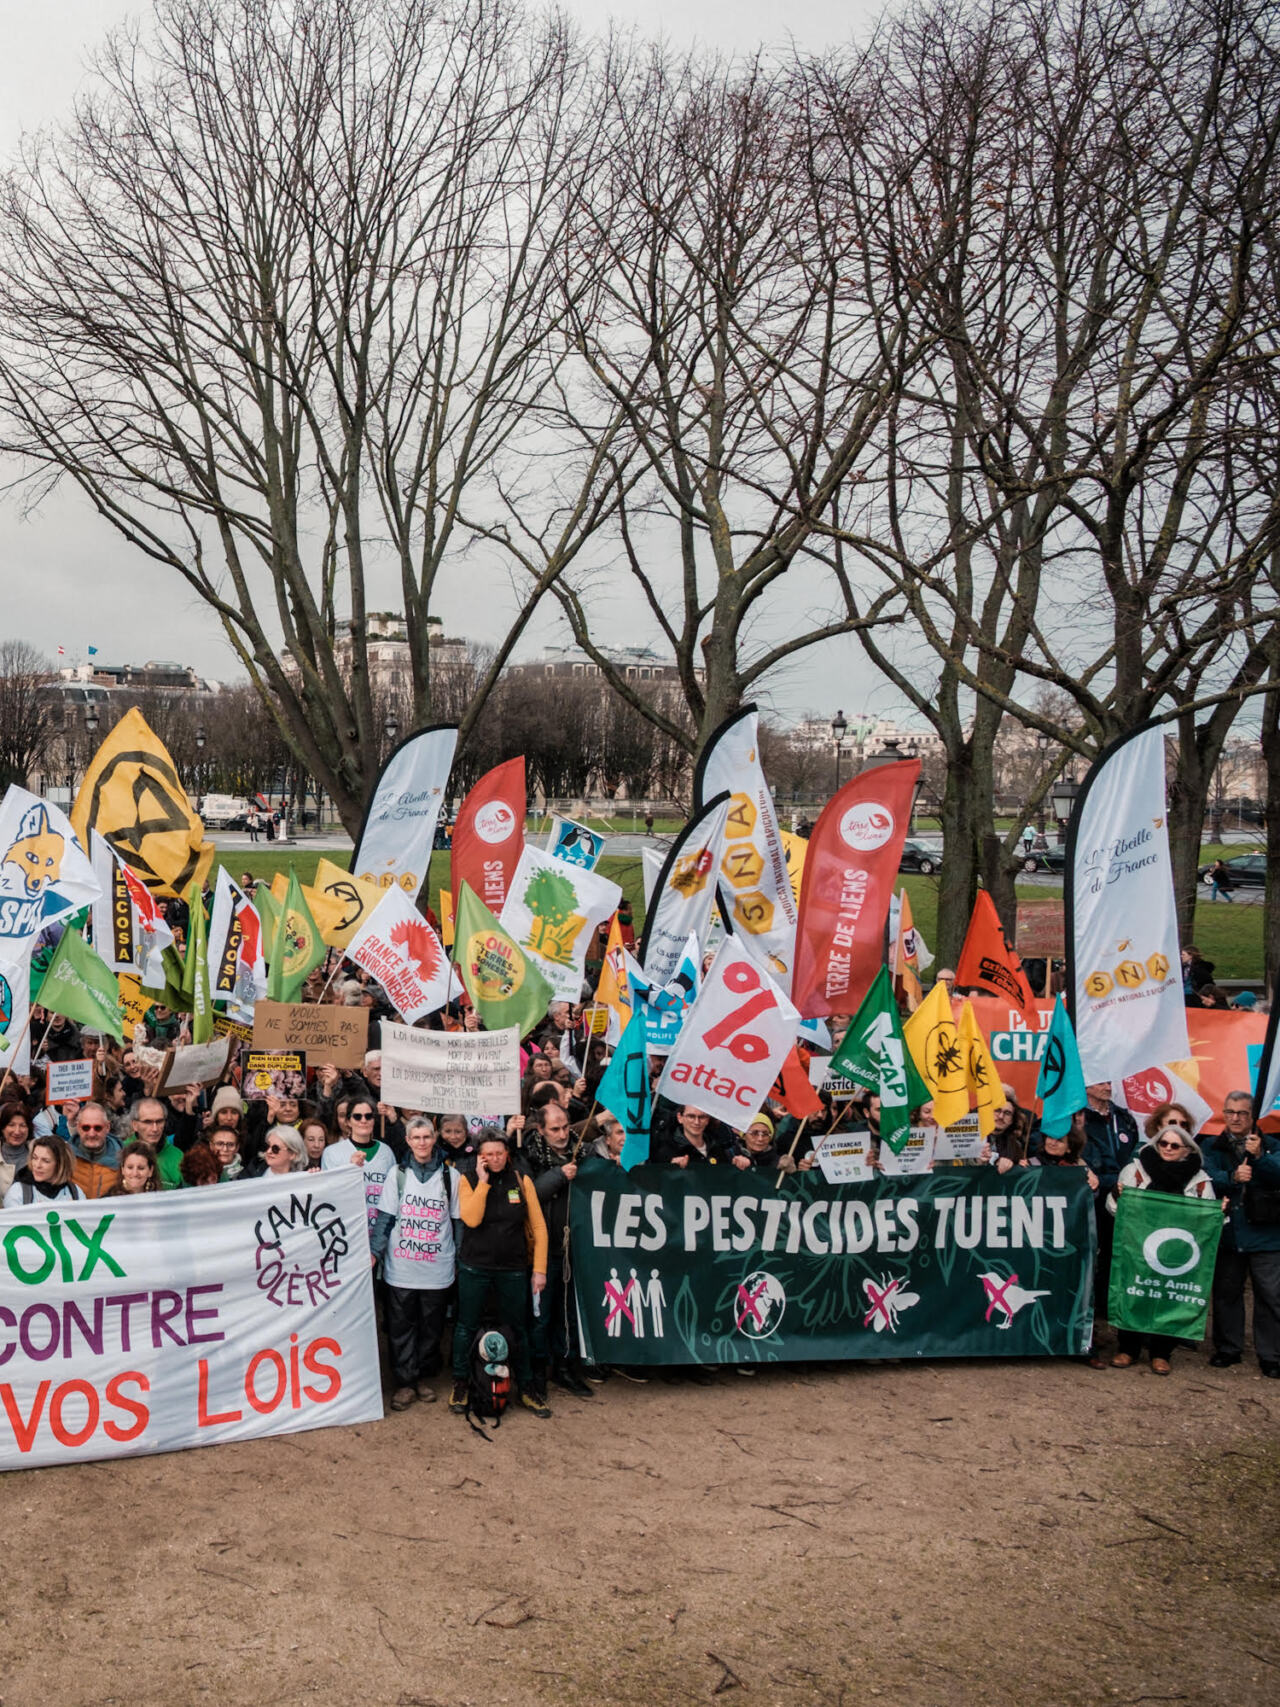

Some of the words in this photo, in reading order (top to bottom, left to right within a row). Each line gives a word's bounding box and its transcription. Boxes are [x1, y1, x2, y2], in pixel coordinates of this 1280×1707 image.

[379, 810, 390, 821] de
[392, 808, 430, 821] France
[770, 850, 783, 886] NATIONAL
[1091, 878, 1103, 894] de
[1106, 854, 1158, 885] France
[483, 860, 505, 904] LIENS
[838, 869, 869, 921] LIENS
[774, 888, 797, 926] SYNDICAT
[833, 923, 856, 948] DE
[486, 936, 513, 960] OUI
[480, 948, 513, 970] TERRES
[354, 947, 415, 1014] ENVIRONNEMENT
[363, 935, 404, 971] FRANCE
[398, 966, 428, 1010] NATURE
[826, 950, 852, 999] TERRE
[1093, 960, 1167, 992] SNA
[1118, 992, 1144, 1004] NATIONAL
[290, 1007, 320, 1019] NOUS
[265, 1018, 282, 1030] NE
[288, 1020, 328, 1033] SOMMES
[339, 1021, 360, 1034] PAS
[284, 1033, 302, 1045] VOS
[304, 1034, 349, 1047] COBAYES
[394, 1030, 407, 1041] LOI
[447, 1040, 463, 1049] MORT
[448, 1050, 463, 1060] MORT
[478, 1050, 502, 1060] VIVANT
[392, 1067, 403, 1079] LOI
[446, 1062, 469, 1073] CANCER
[492, 1061, 511, 1073] TOUS
[670, 1062, 758, 1107] attac
[401, 1204, 442, 1221] COLERE
[406, 1194, 445, 1211] CANCER
[254, 1193, 349, 1273] CANCER
[401, 1218, 441, 1233] CANCER
[591, 1190, 667, 1251] LES
[684, 1195, 919, 1255] PESTICIDES
[935, 1195, 1068, 1250] TUENT
[394, 1248, 438, 1264] COLERE
[398, 1239, 442, 1253] CANCER
[256, 1242, 341, 1308] COLÈRE
[1135, 1275, 1160, 1289] Les
[1164, 1278, 1203, 1294] Amis
[1126, 1286, 1144, 1297] de
[1147, 1286, 1163, 1300] la
[1166, 1290, 1207, 1307] Terre
